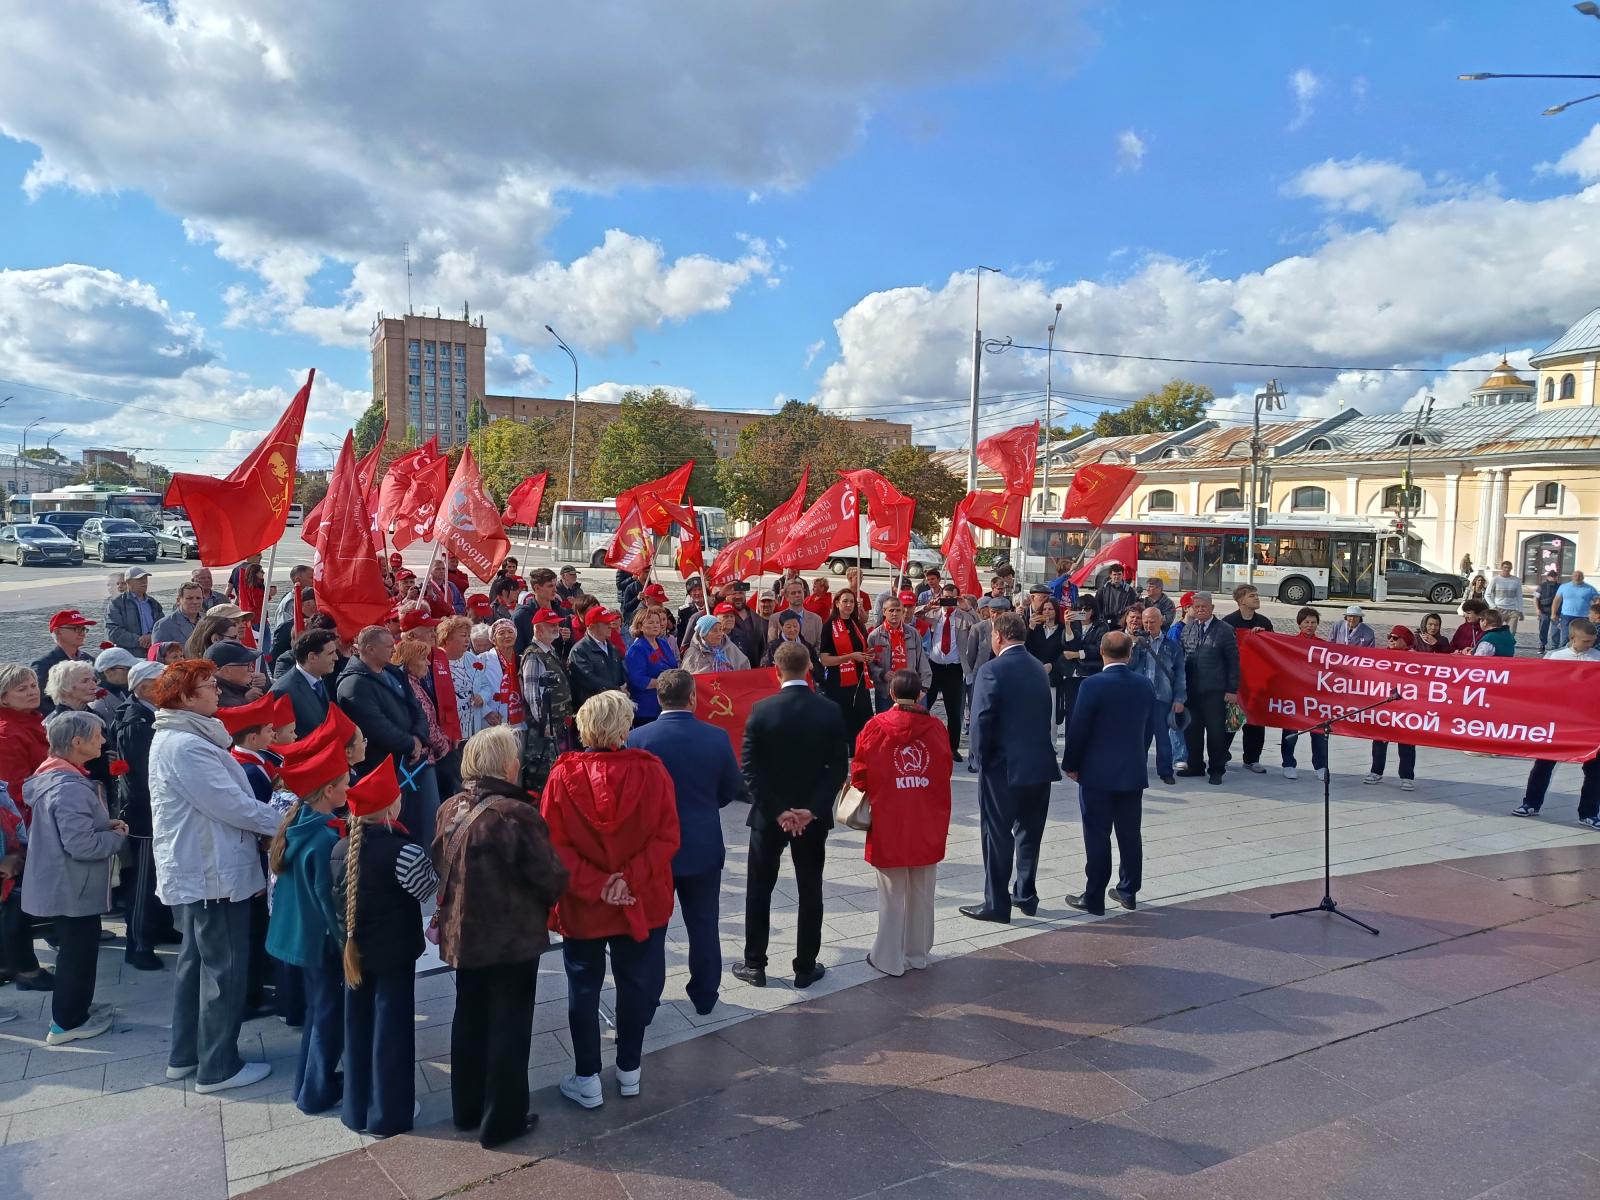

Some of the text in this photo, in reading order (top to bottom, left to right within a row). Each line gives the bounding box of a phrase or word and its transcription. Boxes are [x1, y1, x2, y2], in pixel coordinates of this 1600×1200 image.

[1307, 645, 1510, 684] Приветствуем
[1316, 671, 1491, 708] Кашина В. И.
[1268, 696, 1556, 744] на Рязанской земле!
[895, 776, 930, 789] КПРФ
